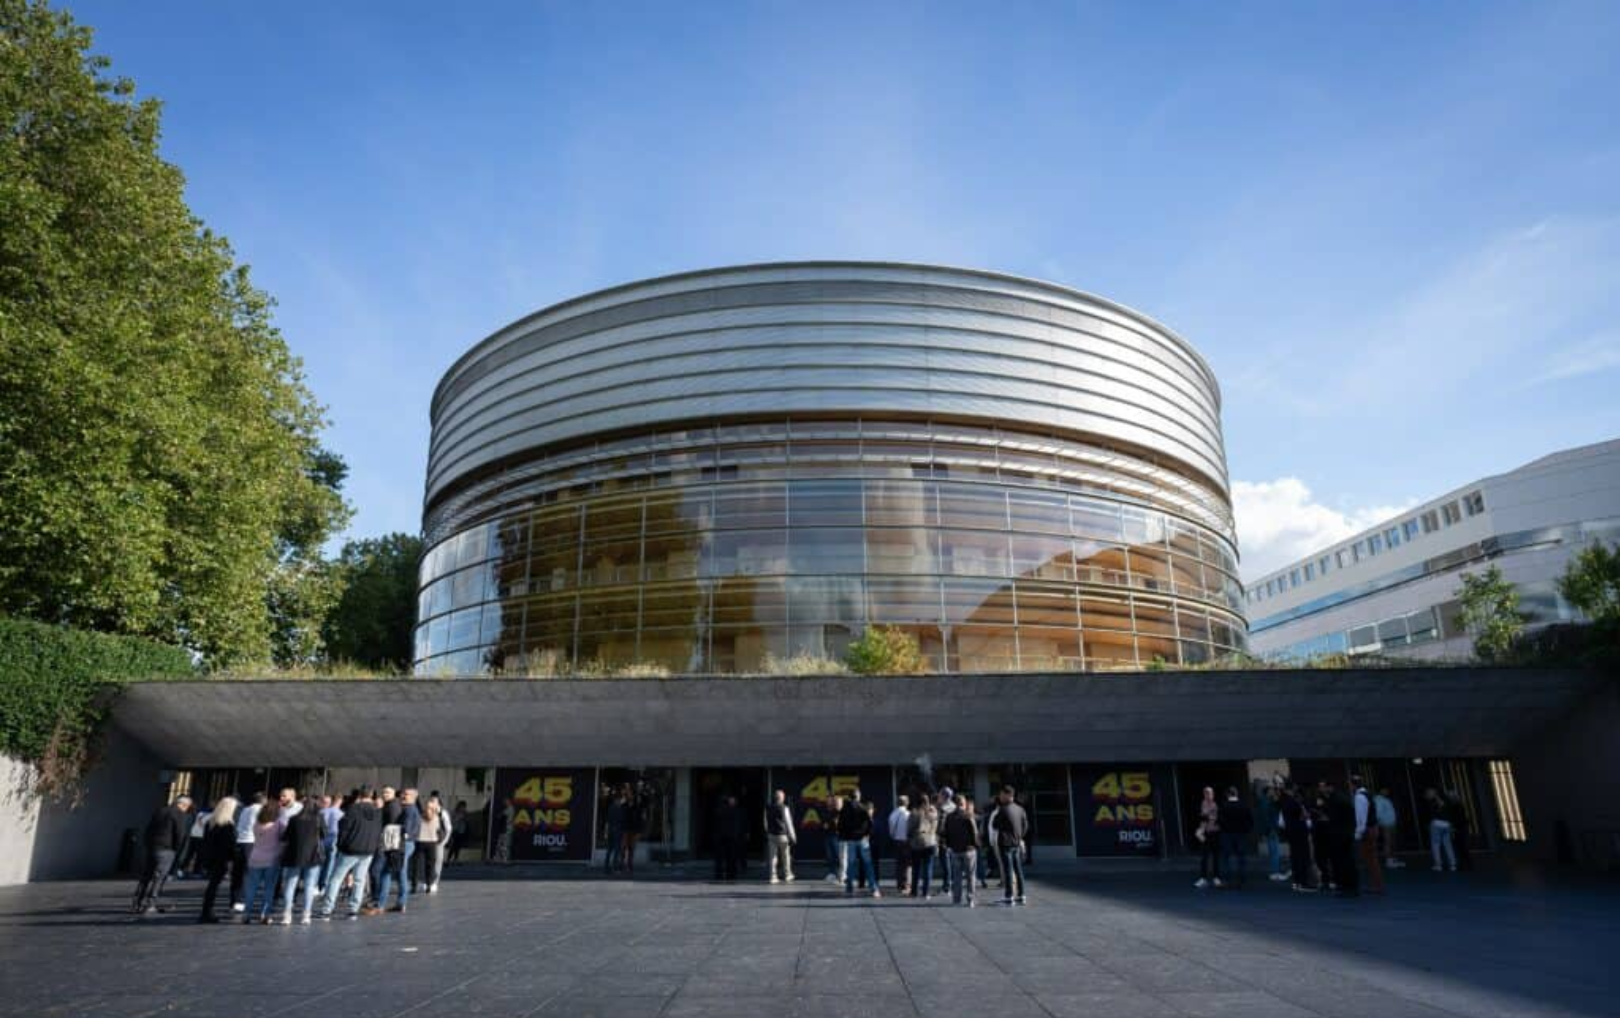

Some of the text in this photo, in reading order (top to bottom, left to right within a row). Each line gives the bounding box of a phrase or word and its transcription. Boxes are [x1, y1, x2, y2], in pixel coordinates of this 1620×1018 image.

[513, 776, 572, 805] 45
[1091, 772, 1151, 799] 45
[514, 809, 571, 828] ANS
[1094, 804, 1154, 823] ANS
